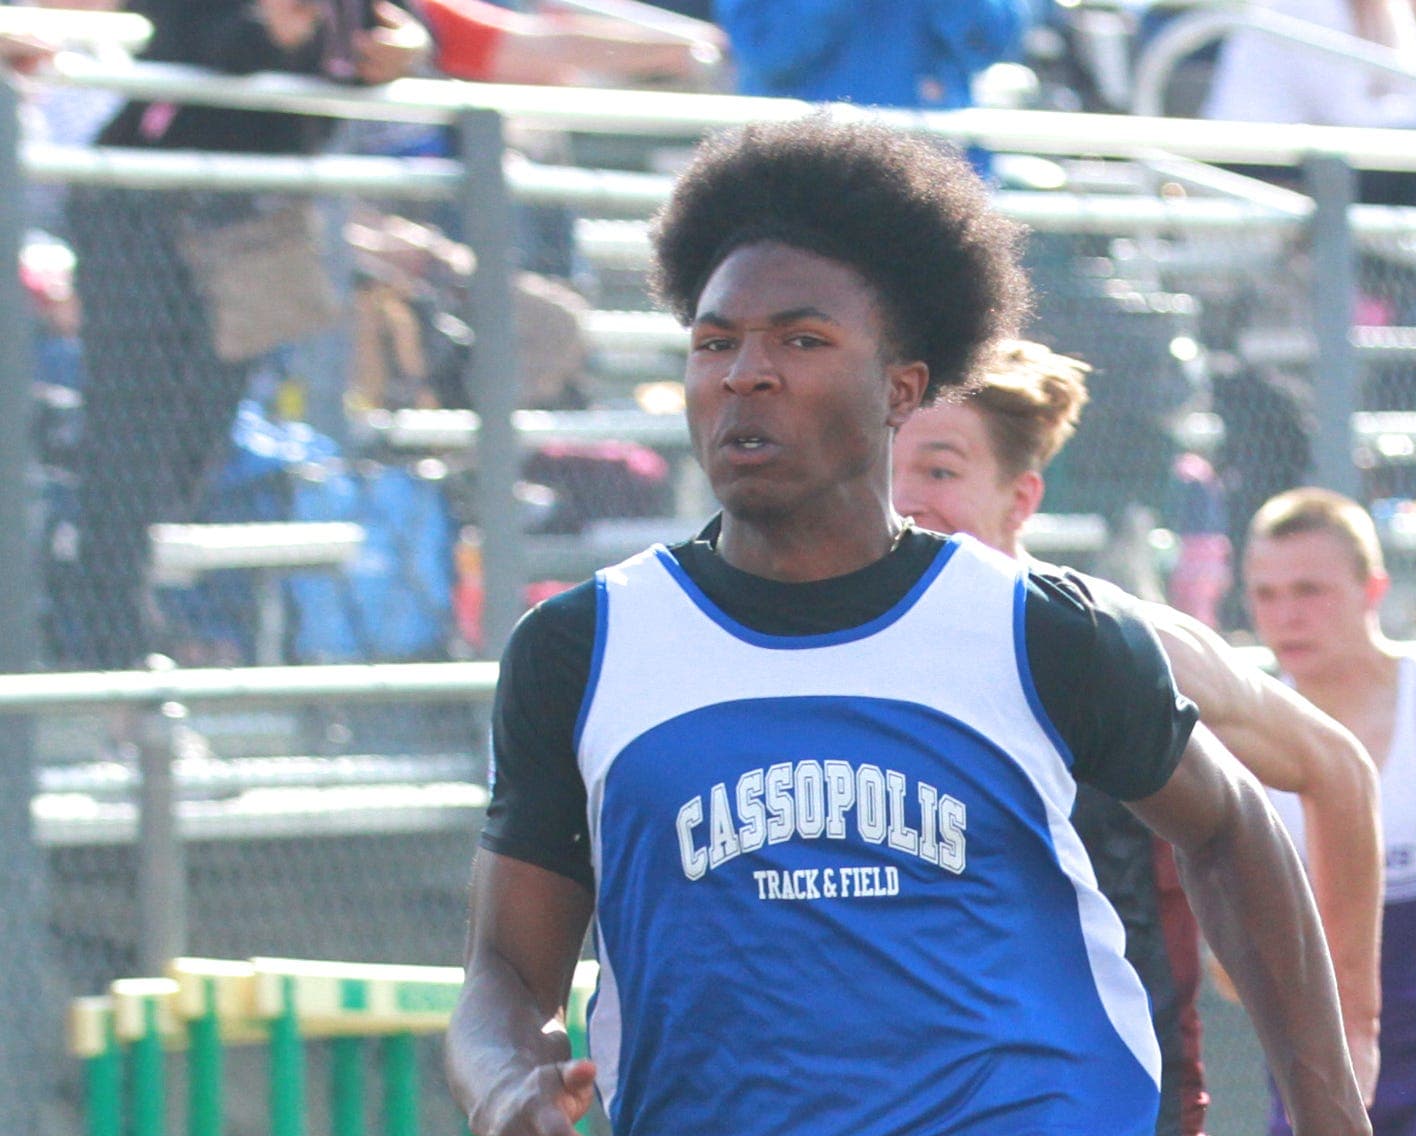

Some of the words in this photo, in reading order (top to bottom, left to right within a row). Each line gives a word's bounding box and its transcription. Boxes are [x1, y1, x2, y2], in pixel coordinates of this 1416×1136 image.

[676, 759, 966, 881] CASSOPOLIS
[753, 869, 820, 900] TRACK
[823, 868, 837, 898] &
[839, 866, 899, 897] FIELD
